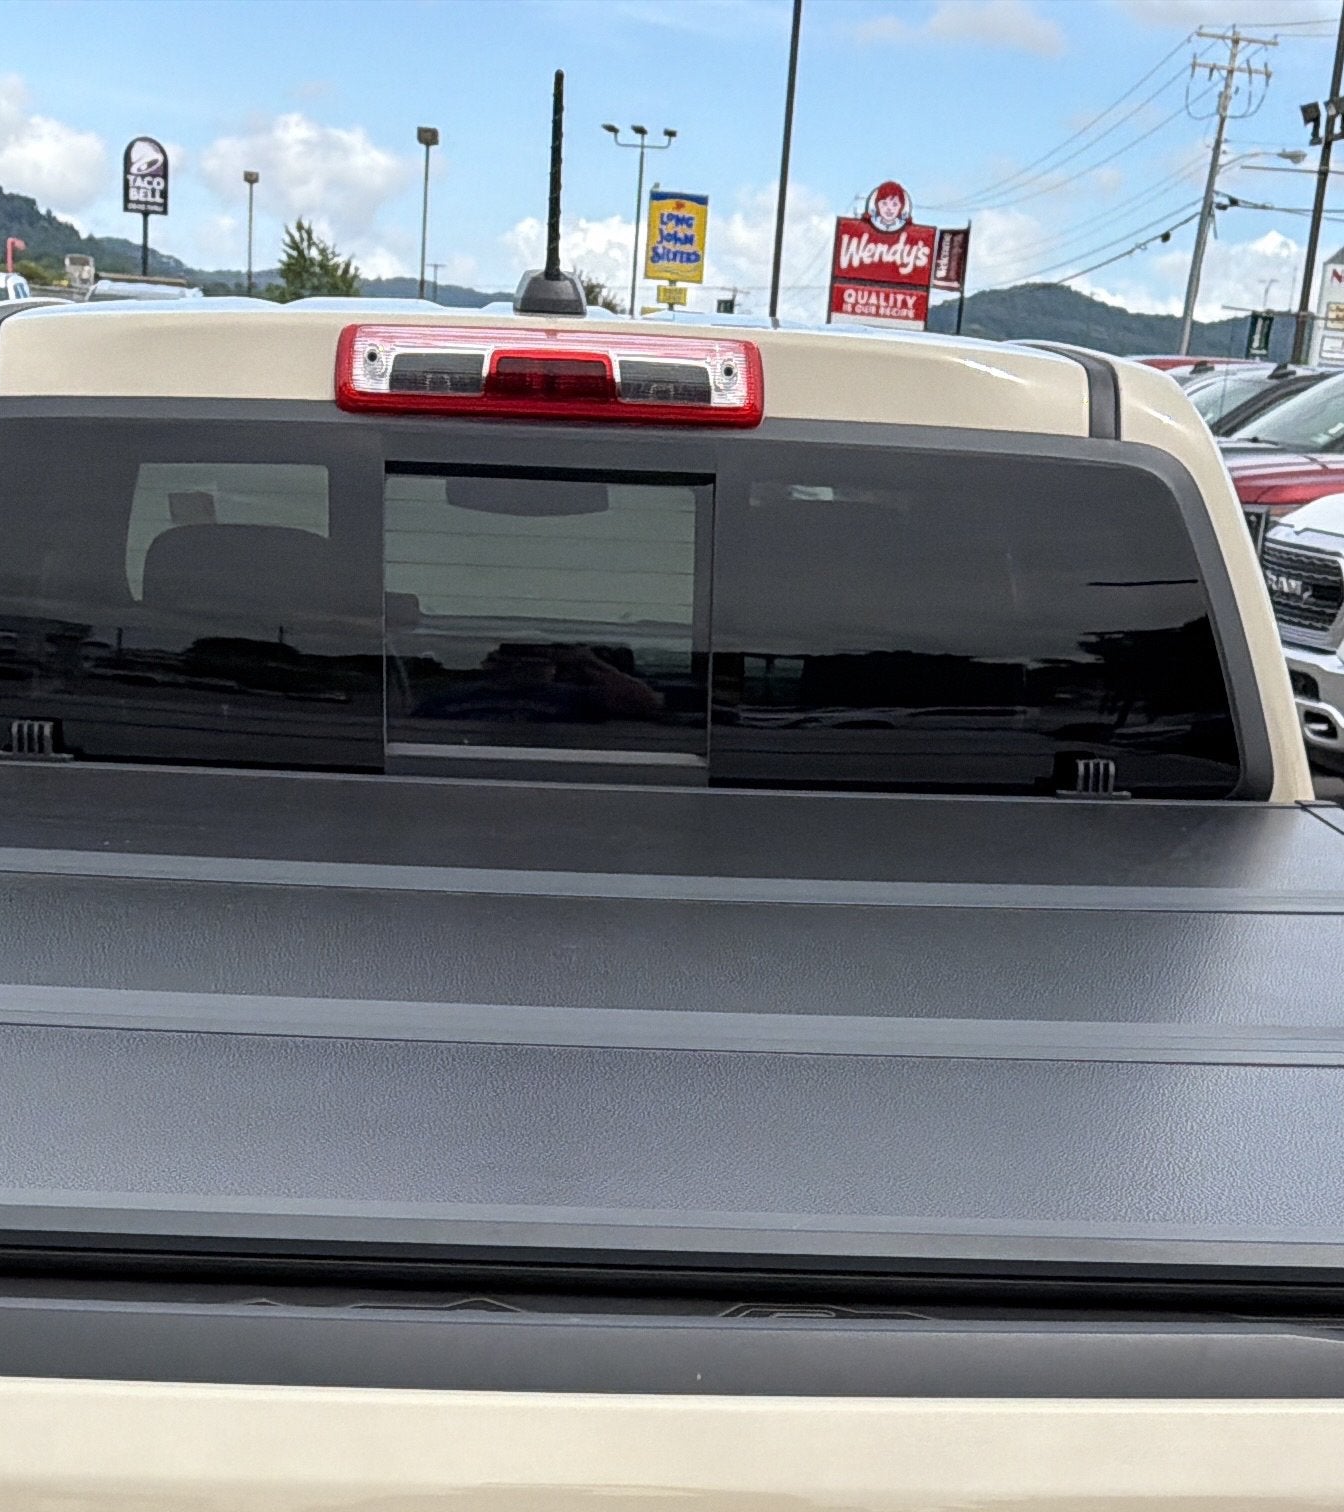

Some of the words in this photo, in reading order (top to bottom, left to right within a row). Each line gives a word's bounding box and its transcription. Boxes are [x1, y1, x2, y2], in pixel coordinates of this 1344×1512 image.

[126, 174, 165, 190] TACO
[128, 187, 165, 204] BELL
[839, 231, 931, 275] Wendy's
[843, 288, 918, 309] QUALITY
